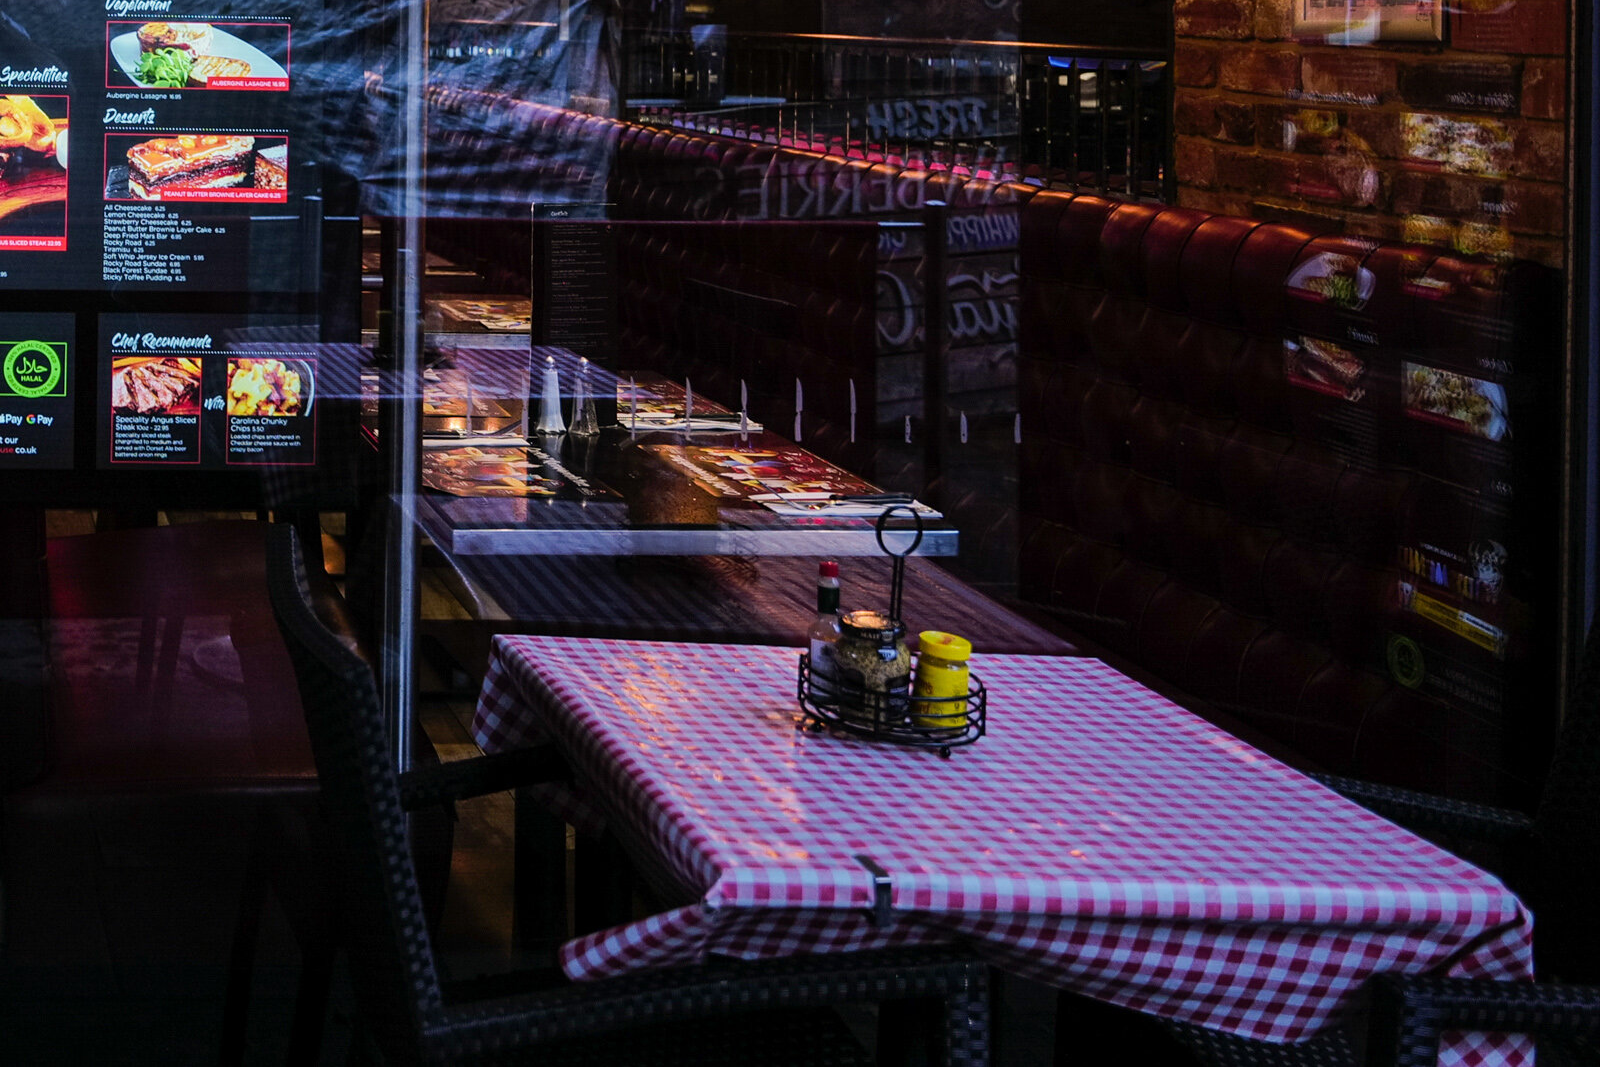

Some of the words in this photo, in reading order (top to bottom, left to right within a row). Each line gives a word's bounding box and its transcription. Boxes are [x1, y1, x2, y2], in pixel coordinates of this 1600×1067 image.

[0, 65, 68, 86] Specialities
[103, 107, 155, 125] Desserts
[112, 333, 138, 351] Chef
[142, 333, 212, 349] Recommends
[6, 414, 22, 426] Pay
[37, 414, 53, 426] Pay
[116, 416, 149, 424] Speciality
[151, 416, 173, 424] Angus
[261, 417, 287, 426] Chunky
